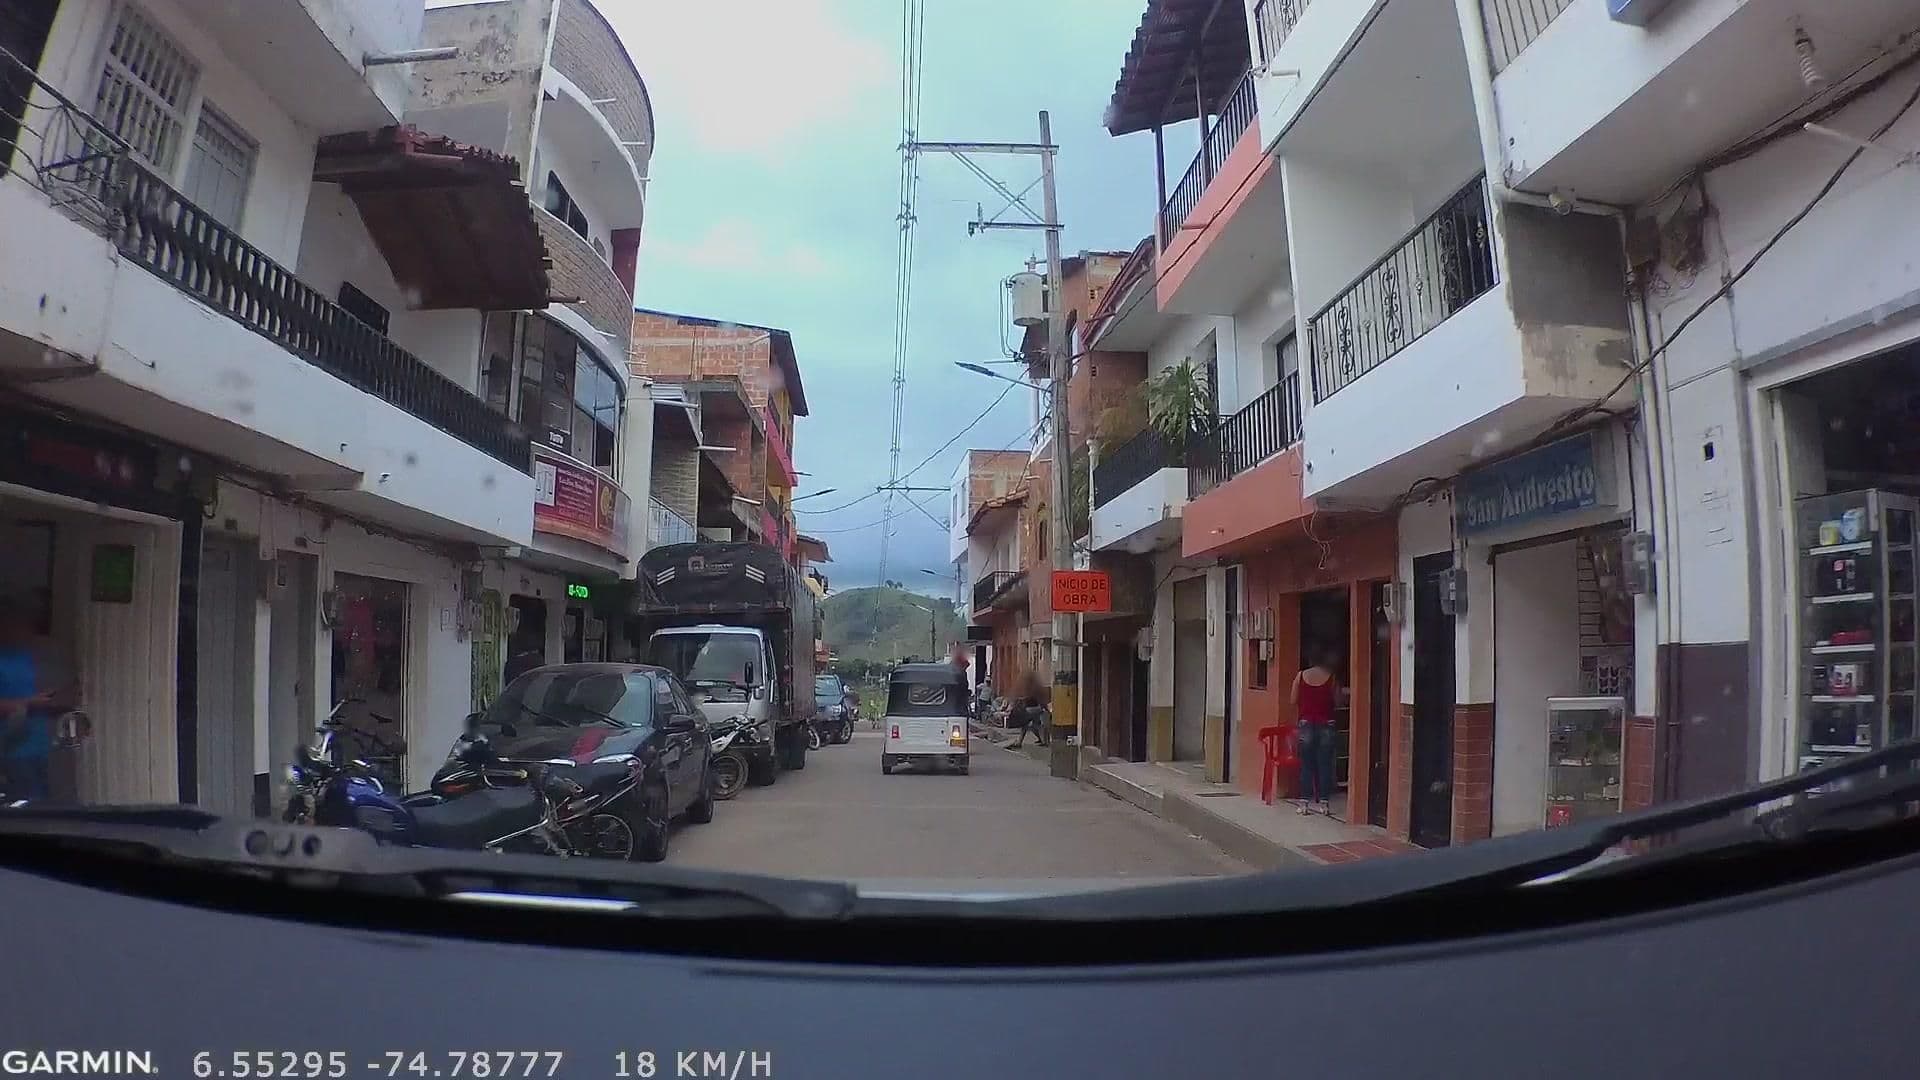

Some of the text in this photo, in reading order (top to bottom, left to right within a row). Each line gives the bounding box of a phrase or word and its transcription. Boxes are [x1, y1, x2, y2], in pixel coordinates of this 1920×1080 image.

[1466, 464, 1594, 527] San Andresito
[1091, 578, 1107, 590] DE
[1063, 594, 1098, 605] OBRA
